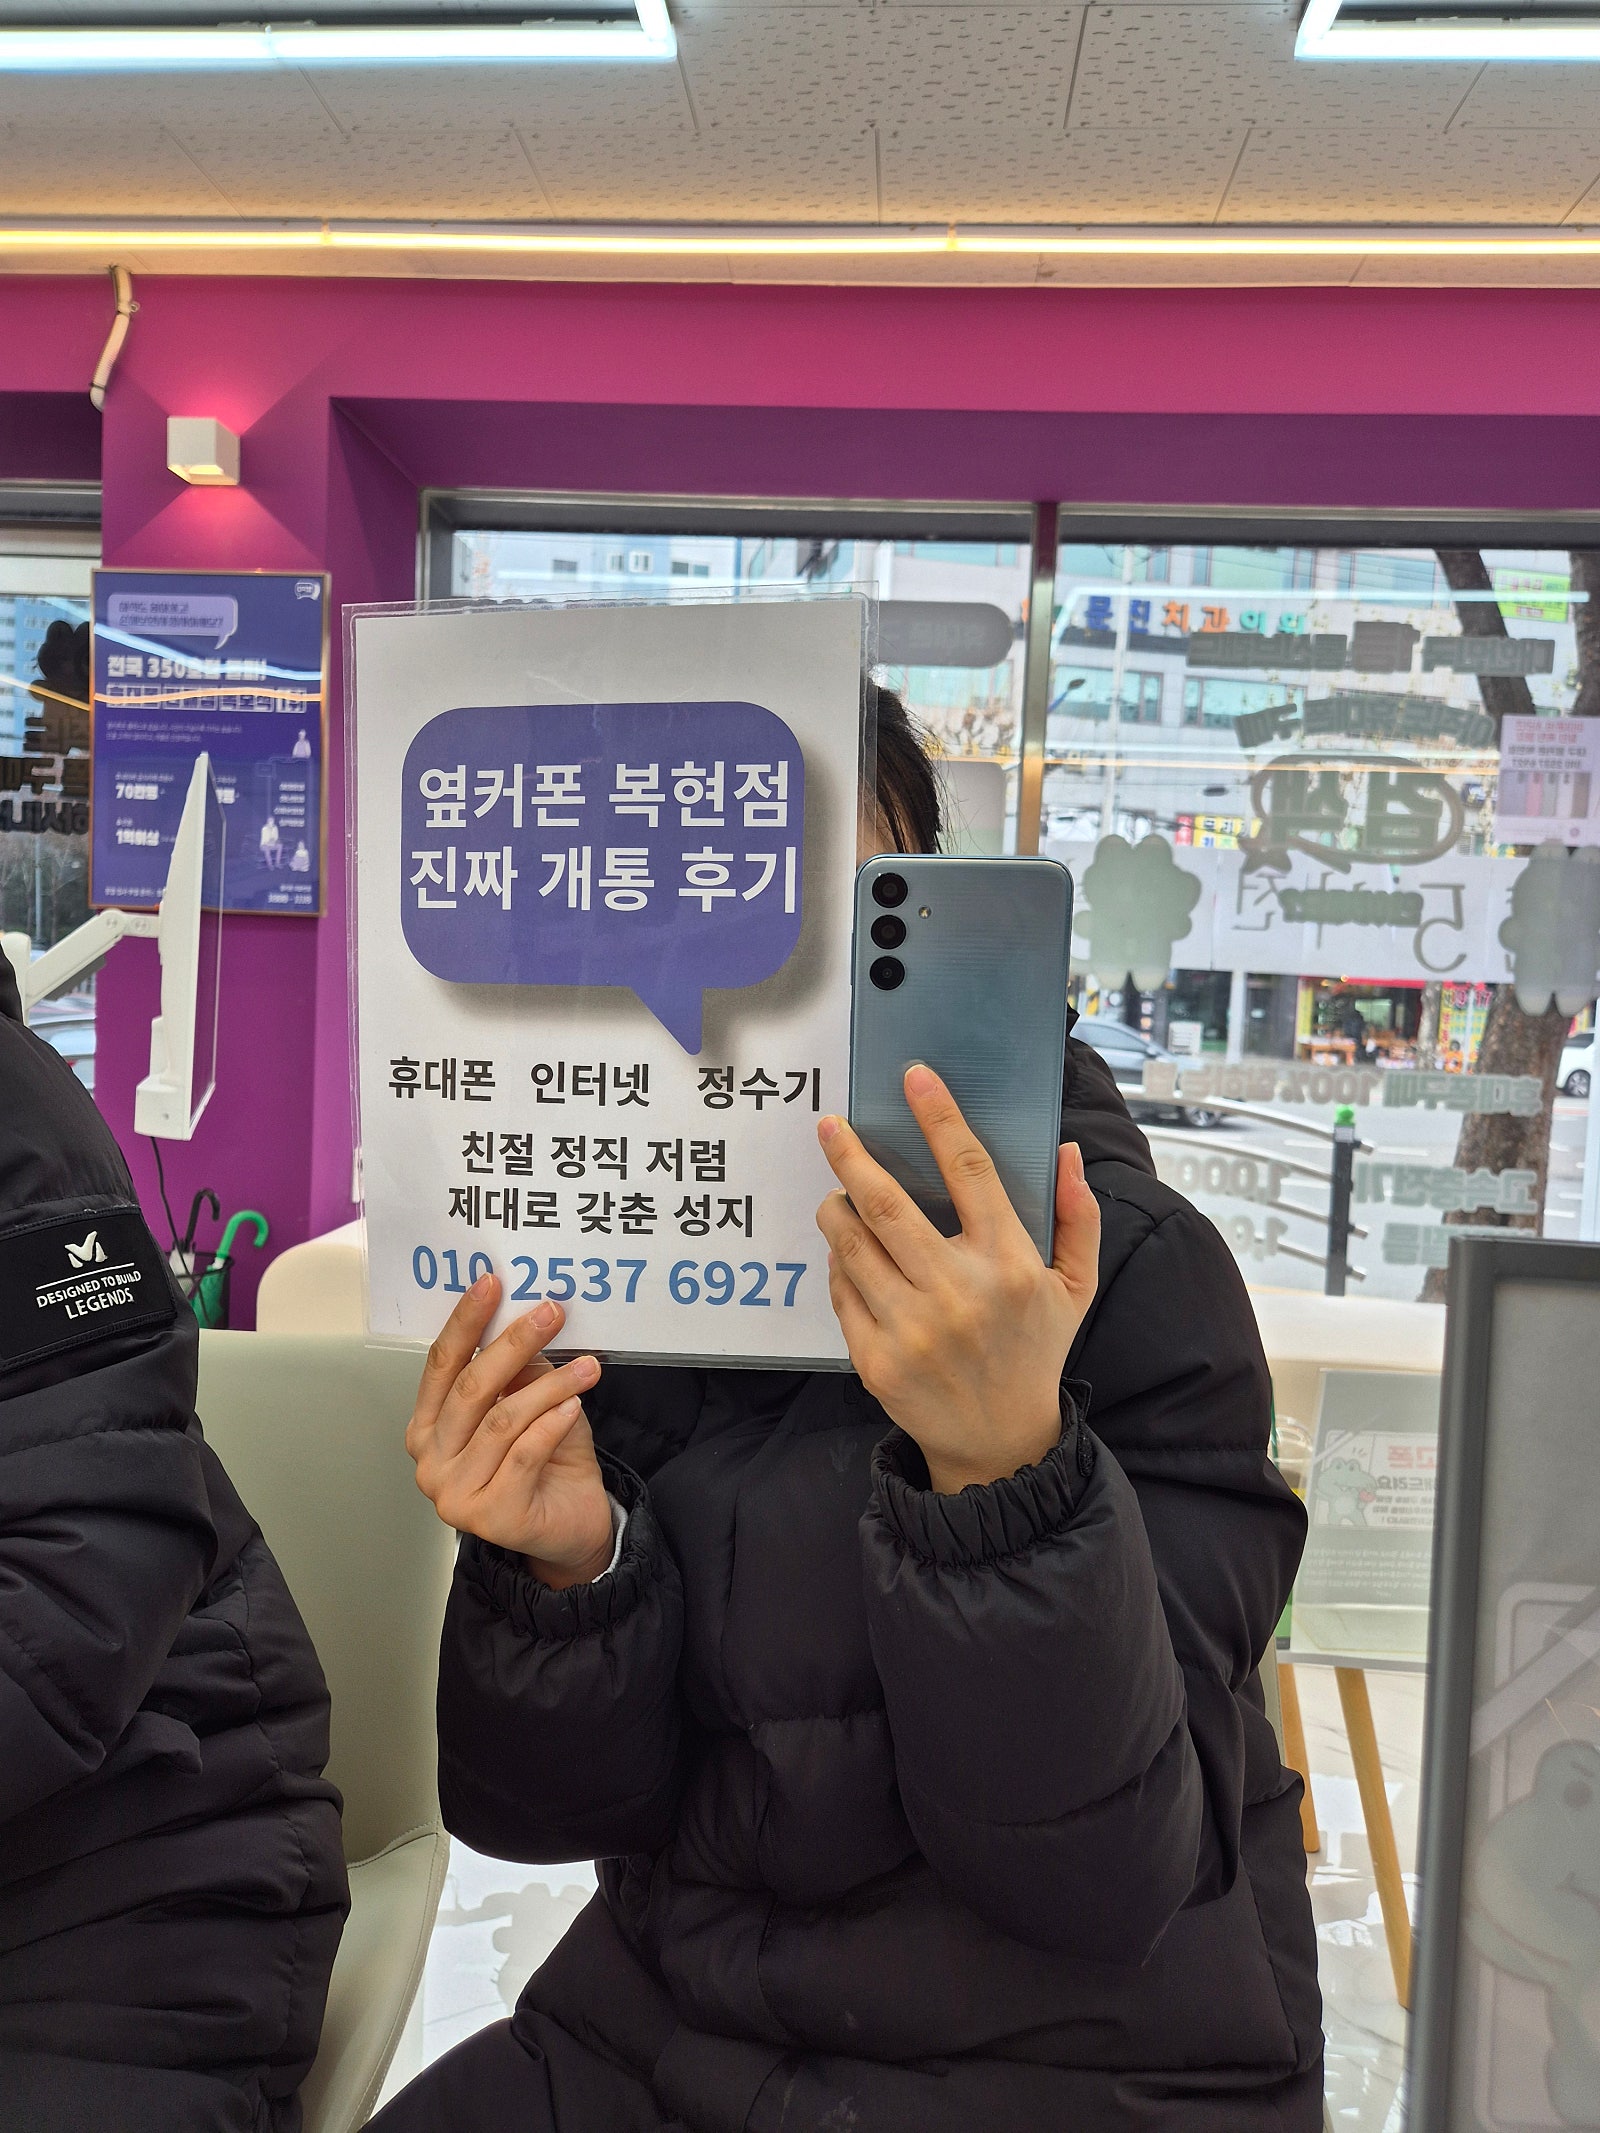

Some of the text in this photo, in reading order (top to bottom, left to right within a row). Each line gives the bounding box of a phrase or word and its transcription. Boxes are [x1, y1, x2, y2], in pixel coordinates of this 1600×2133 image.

[107, 655, 143, 678] 전국
[419, 760, 789, 828] 옆커폰 복현점
[410, 846, 797, 914] 진짜 개통 후기
[388, 1056, 821, 1112] 휴대폰 인터넷 정수기
[461, 1131, 726, 1182] 친절 정직 저렴
[448, 1186, 753, 1238] 제대로 갖춘 성지
[36, 1270, 142, 1309] DESIGNED TO BUILD
[65, 1287, 134, 1320] LEGENDS
[510, 1255, 647, 1303] 2537
[668, 1259, 807, 1307] 6927
